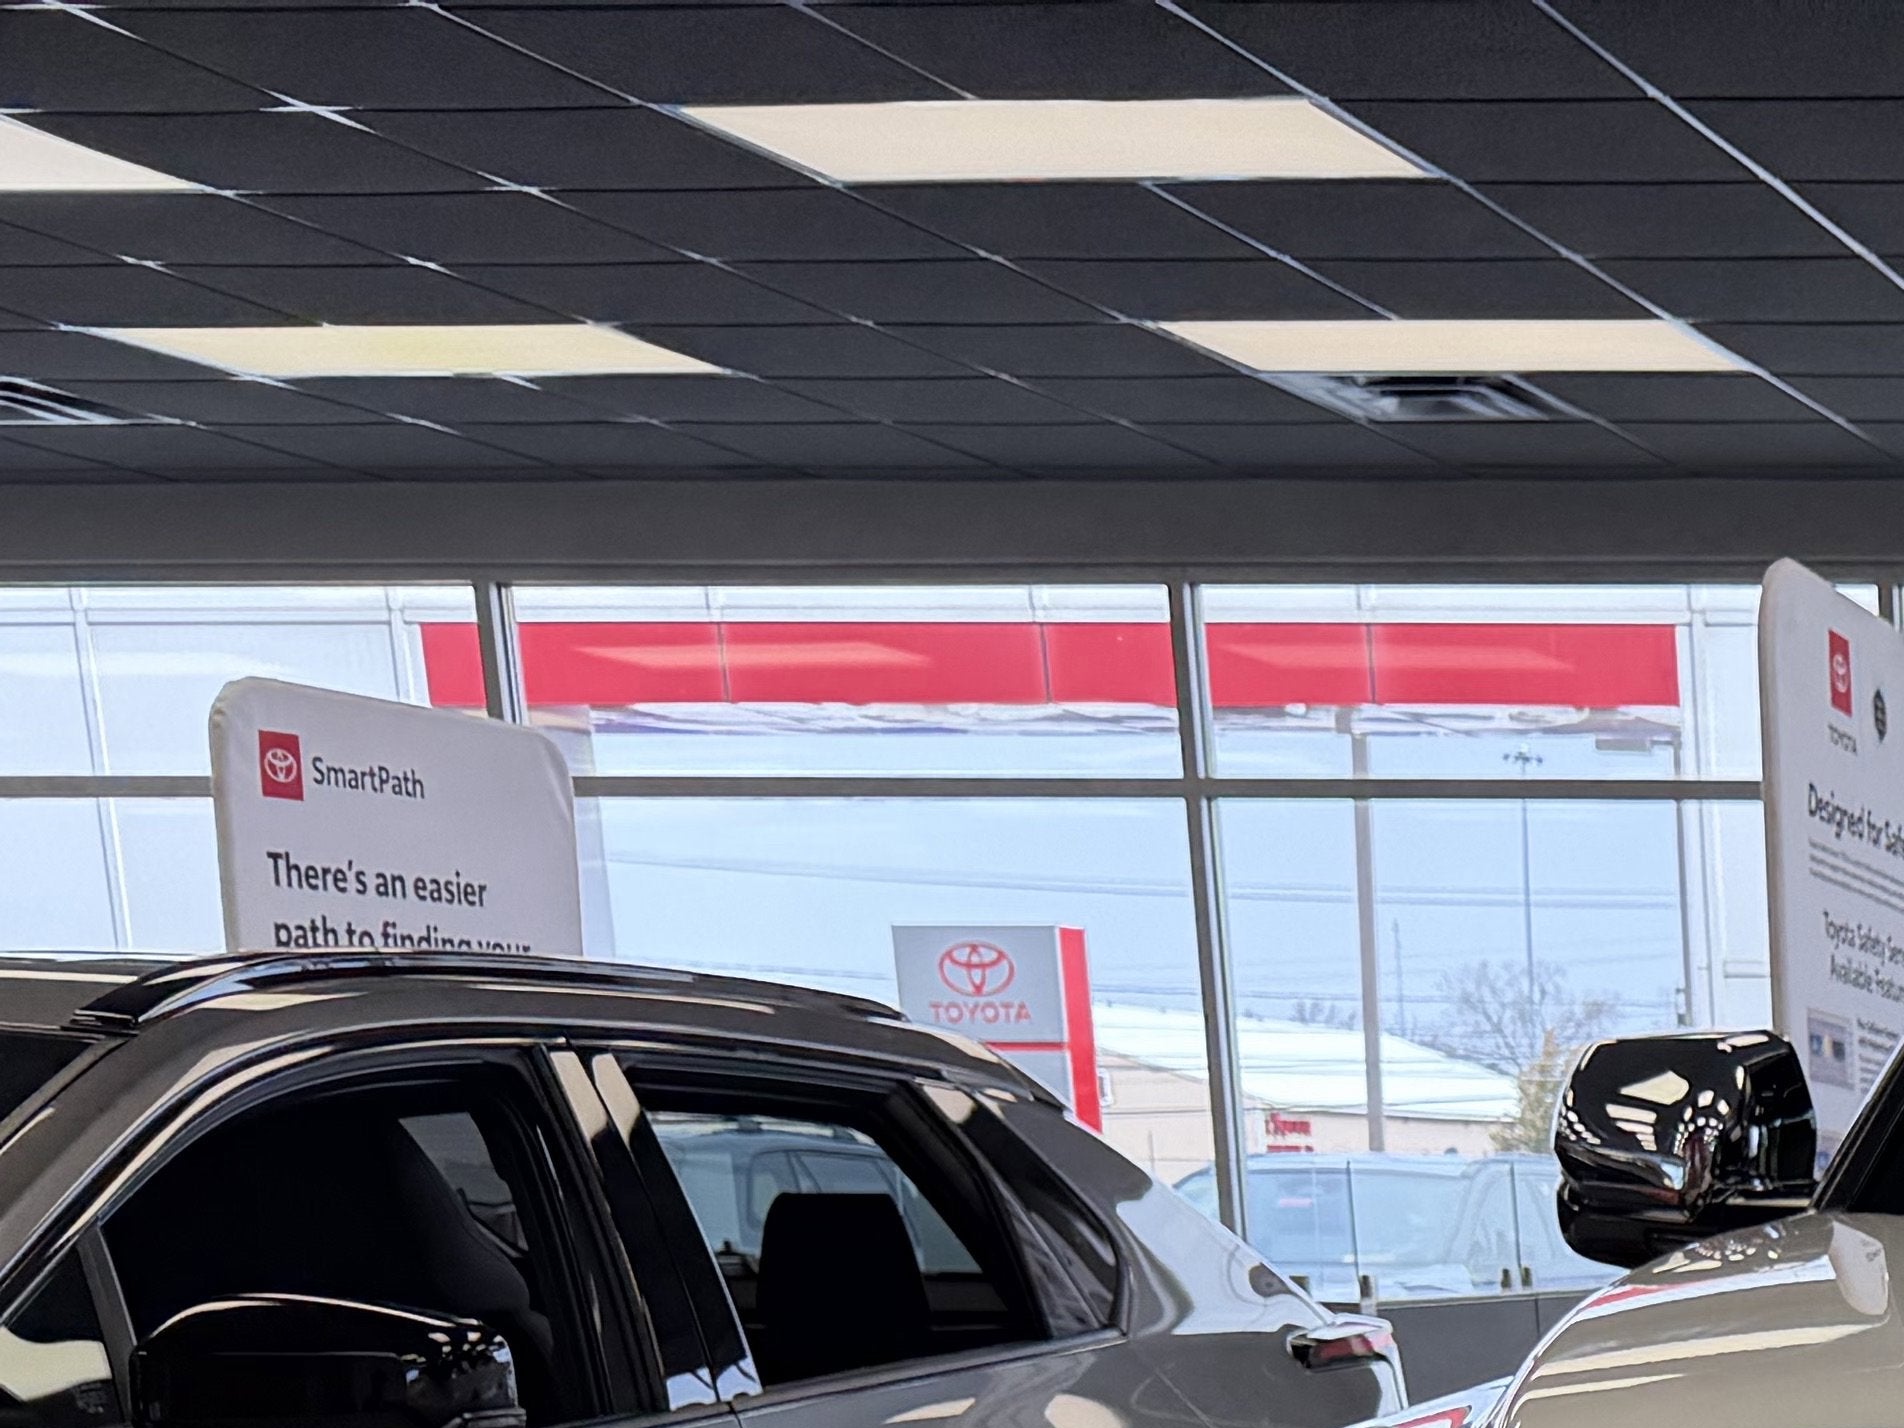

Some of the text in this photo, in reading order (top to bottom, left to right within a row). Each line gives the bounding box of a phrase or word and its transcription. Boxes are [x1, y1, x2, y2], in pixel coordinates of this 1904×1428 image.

[312, 757, 425, 800] SmartPath
[1808, 782, 1864, 839] Designed
[1867, 810, 1883, 846] for
[266, 851, 487, 907] There's an easier
[1823, 909, 1855, 950] Toyota
[1857, 923, 1885, 967] Safety
[929, 1001, 1031, 1024] TOYOTA
